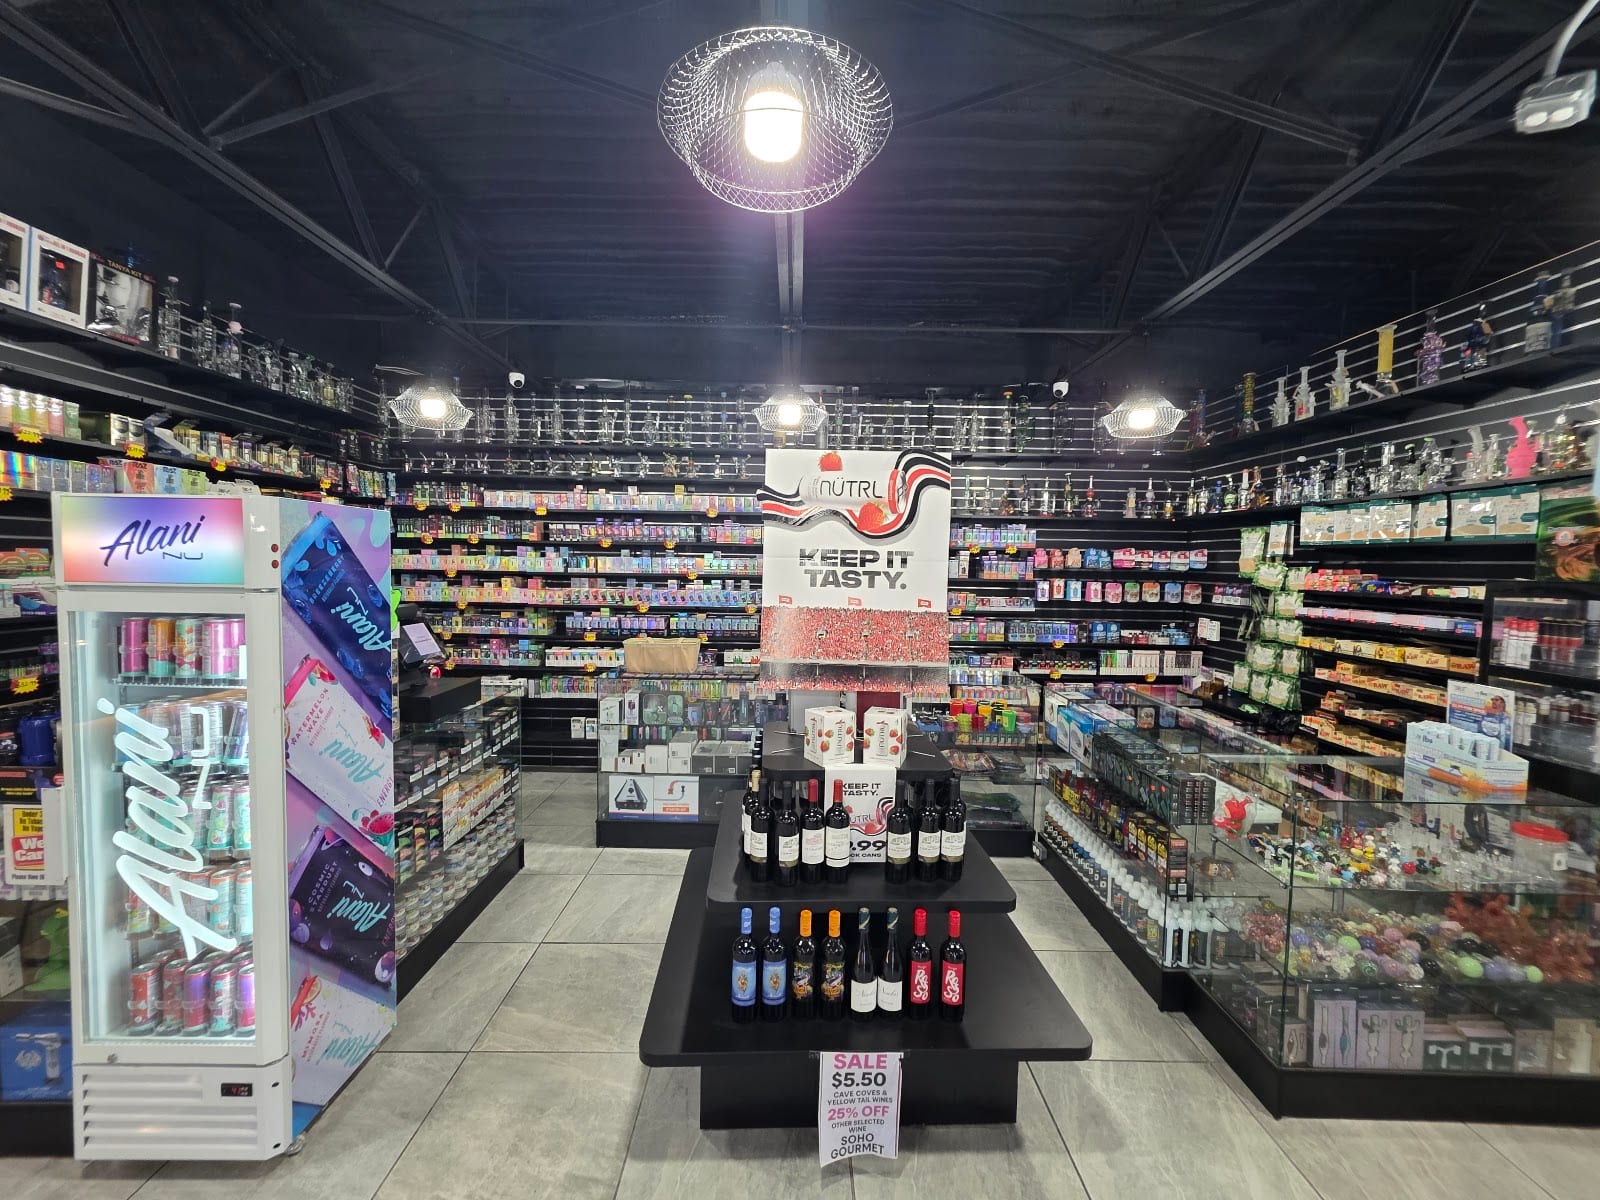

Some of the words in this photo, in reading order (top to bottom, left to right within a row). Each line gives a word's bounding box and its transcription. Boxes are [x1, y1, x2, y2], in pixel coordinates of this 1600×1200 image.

[100, 515, 206, 567] Alani
[163, 551, 204, 560] NU
[799, 548, 880, 568] KEEP
[886, 550, 914, 569] IT
[804, 569, 907, 590] TASTY.
[330, 601, 391, 653] Alani
[291, 687, 329, 746] WATERMELON
[305, 708, 324, 734] WAVE
[318, 738, 385, 783] Alani
[96, 697, 238, 961] Alani
[307, 862, 332, 904] COSMIC
[310, 861, 339, 913] STARDUST
[326, 895, 391, 933] Alani
[833, 1053, 888, 1070] SALE
[831, 1071, 887, 1089] $5.50
[827, 1098, 856, 1106] YELLOW
[833, 1091, 854, 1099] CAVE
[827, 1107, 859, 1121] 25%
[861, 1105, 890, 1117] OFF
[831, 1120, 853, 1129] OTHER
[840, 1133, 875, 1146] SOHO
[830, 1143, 885, 1160] GOURMET
